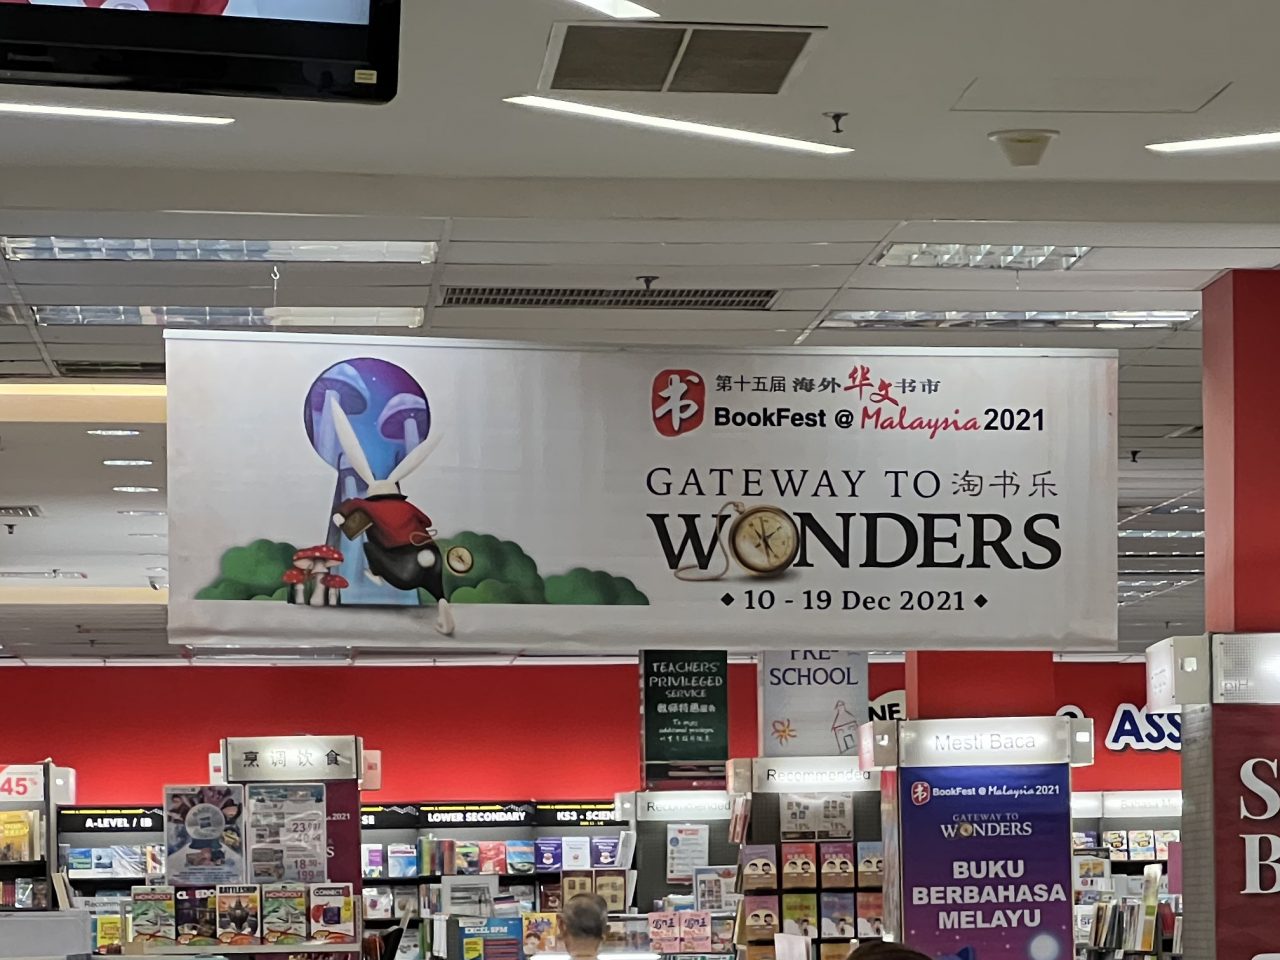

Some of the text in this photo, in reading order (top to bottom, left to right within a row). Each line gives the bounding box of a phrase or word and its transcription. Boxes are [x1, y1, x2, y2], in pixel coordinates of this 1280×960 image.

[716, 365, 941, 406] 第十五届 海外华文书市
[714, 406, 1045, 439] BookFest @ Malaysia 2021
[646, 467, 941, 499] GATEWAY TO
[951, 469, 1059, 499] 淘书乐
[647, 506, 1062, 573] WONDERS
[744, 590, 775, 610] 10
[803, 590, 830, 610] 19
[841, 590, 891, 610] Dec
[900, 590, 964, 610] 2021
[652, 661, 720, 673] TEACHERS'
[649, 675, 723, 688] PRIVILEGED
[769, 668, 859, 686] SCHOOL
[665, 689, 707, 698] SERVICE
[934, 733, 1036, 751] Mesti Baca
[932, 784, 1060, 799] BookFest @ Malaysia 2021
[85, 819, 129, 829] A-LEVEL
[428, 811, 527, 823] LOWER SECONDARY
[556, 811, 577, 821] KS3
[952, 812, 1019, 823] GATEWAY TO
[940, 821, 1032, 838] WONDERS
[952, 859, 1025, 879] BUKU
[912, 882, 1067, 905] BERBAHASA
[938, 907, 1042, 930] MELAYU
